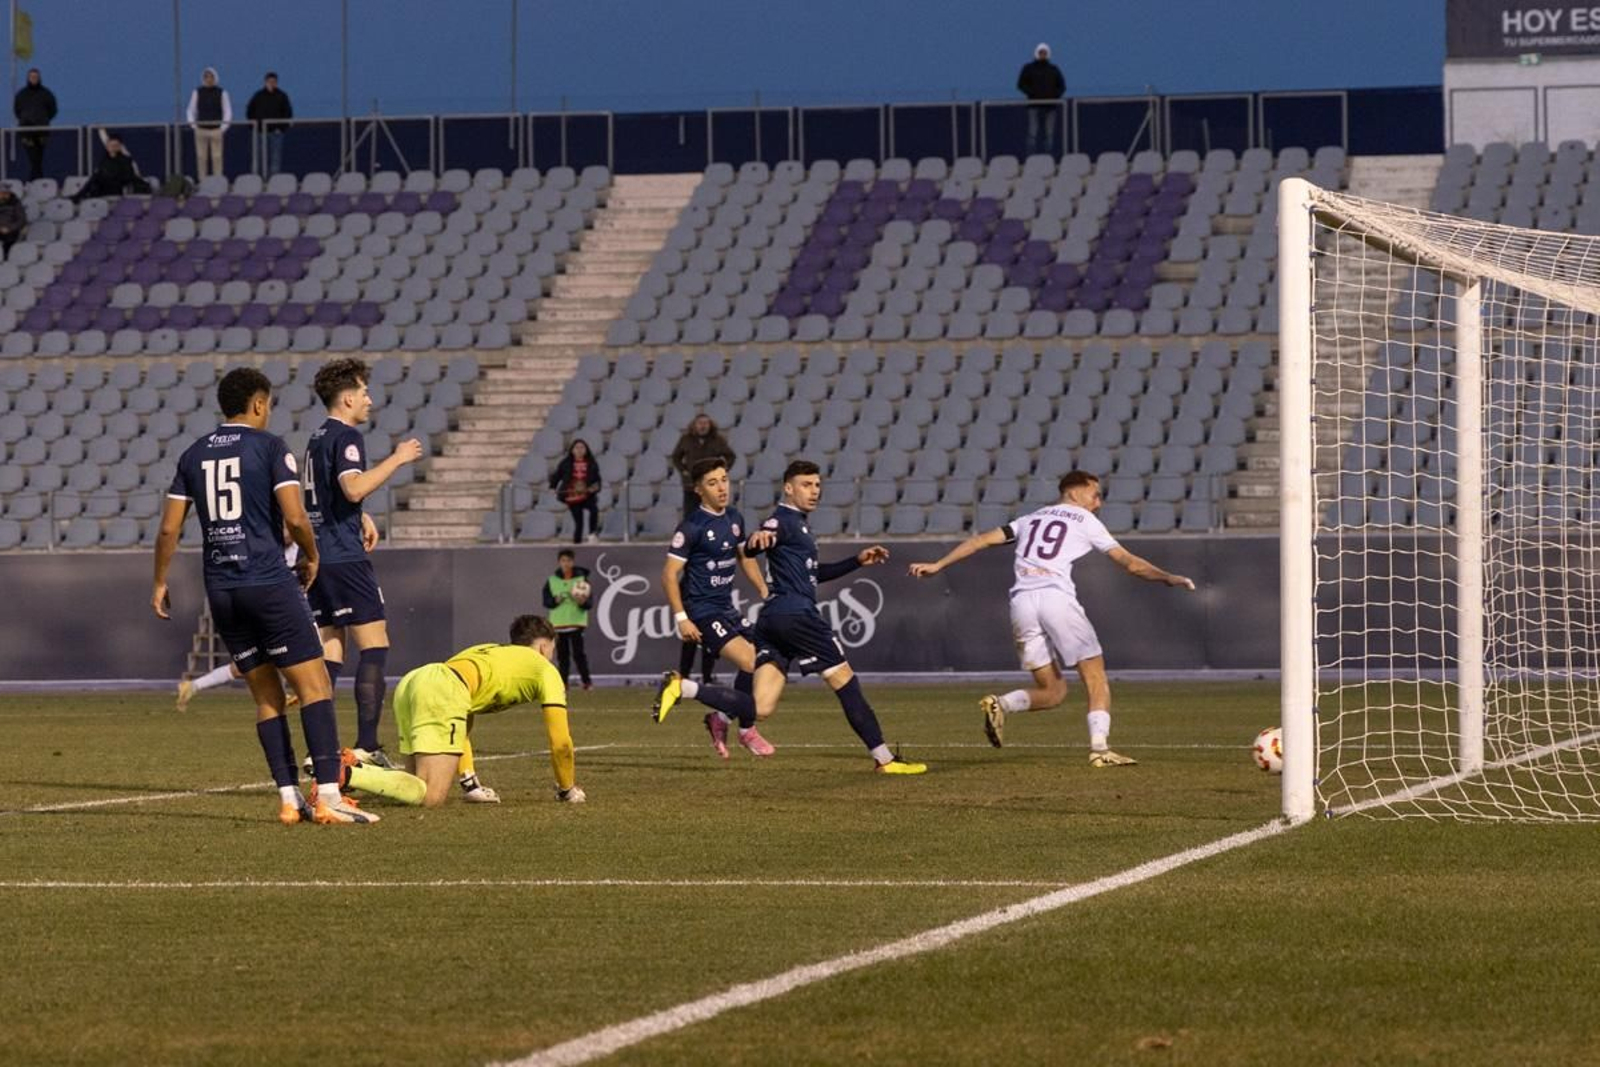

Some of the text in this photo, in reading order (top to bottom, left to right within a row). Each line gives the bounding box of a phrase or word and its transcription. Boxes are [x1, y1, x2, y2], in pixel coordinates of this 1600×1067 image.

[1502, 8, 1562, 33] HOY
[201, 457, 243, 521] 15
[1023, 519, 1068, 560] 19
[711, 621, 728, 637] 2
